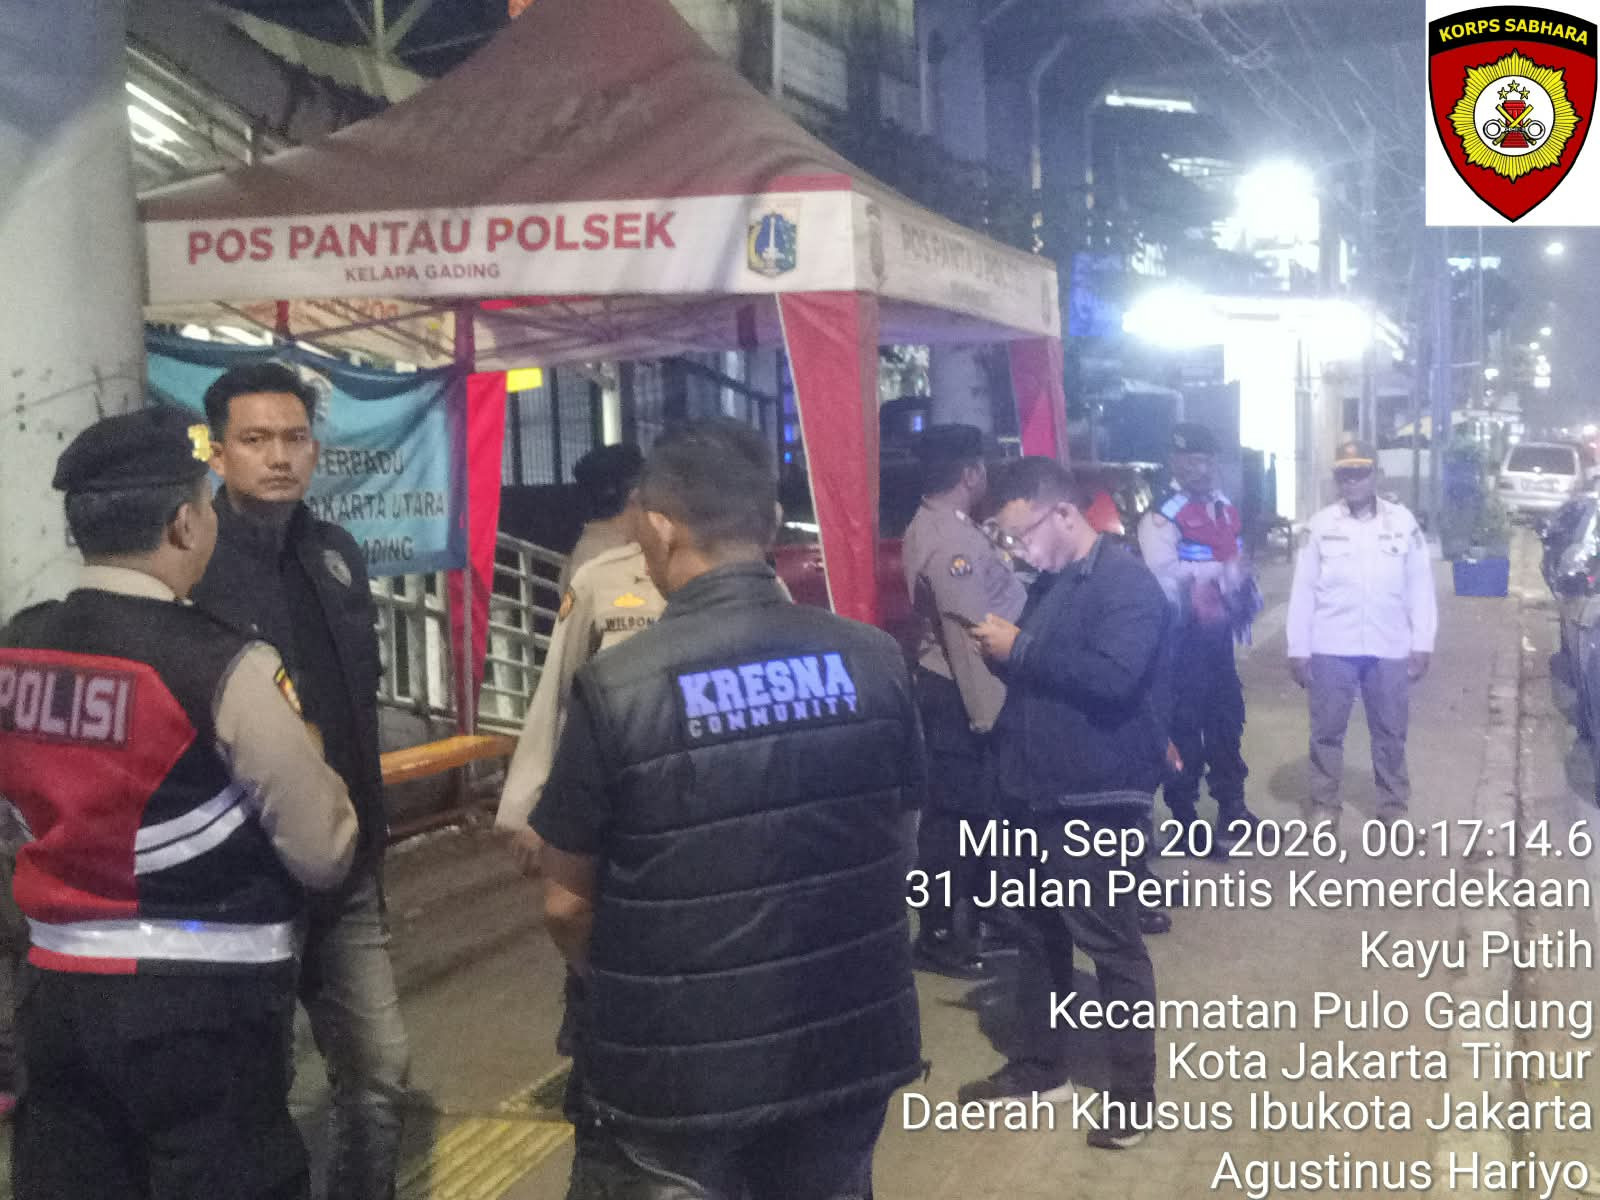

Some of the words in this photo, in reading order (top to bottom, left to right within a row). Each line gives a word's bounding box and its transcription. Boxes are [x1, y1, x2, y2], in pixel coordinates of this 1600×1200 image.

[188, 227, 273, 265] POS
[289, 218, 471, 260] PANTAU
[487, 211, 677, 252] POLSEK
[345, 264, 420, 282] KELAPA
[425, 263, 500, 280] GADING
[392, 491, 445, 519] UTARA
[0, 666, 130, 744] POLISI
[677, 652, 857, 718] KRESNA
[687, 694, 858, 738] COMMUNITY
